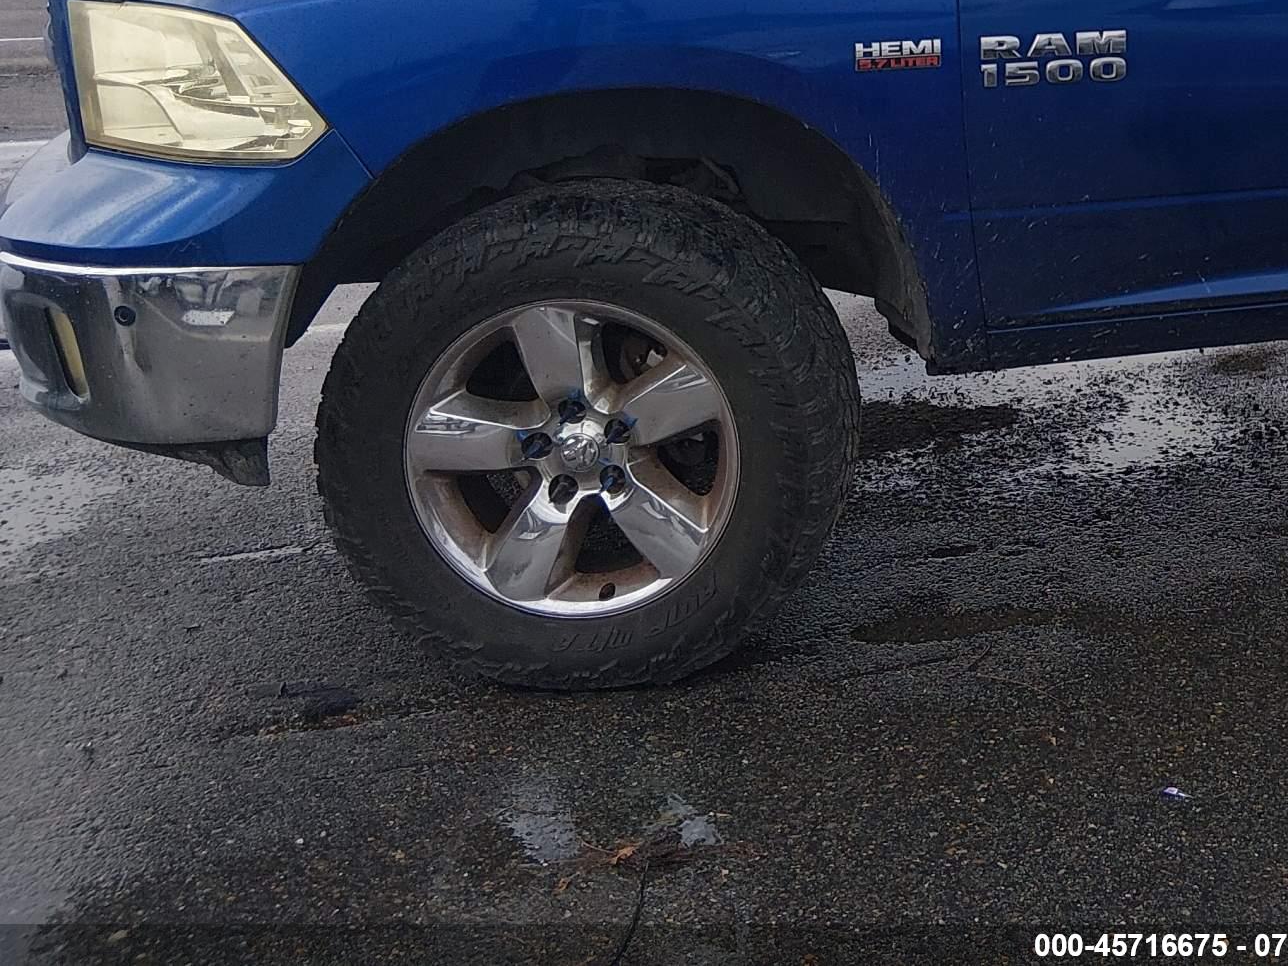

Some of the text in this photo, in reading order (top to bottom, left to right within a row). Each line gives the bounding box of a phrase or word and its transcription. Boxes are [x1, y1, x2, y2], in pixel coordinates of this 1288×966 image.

[855, 39, 941, 58] HEMI
[980, 30, 1128, 60] RAM
[980, 57, 1128, 88] 1500
